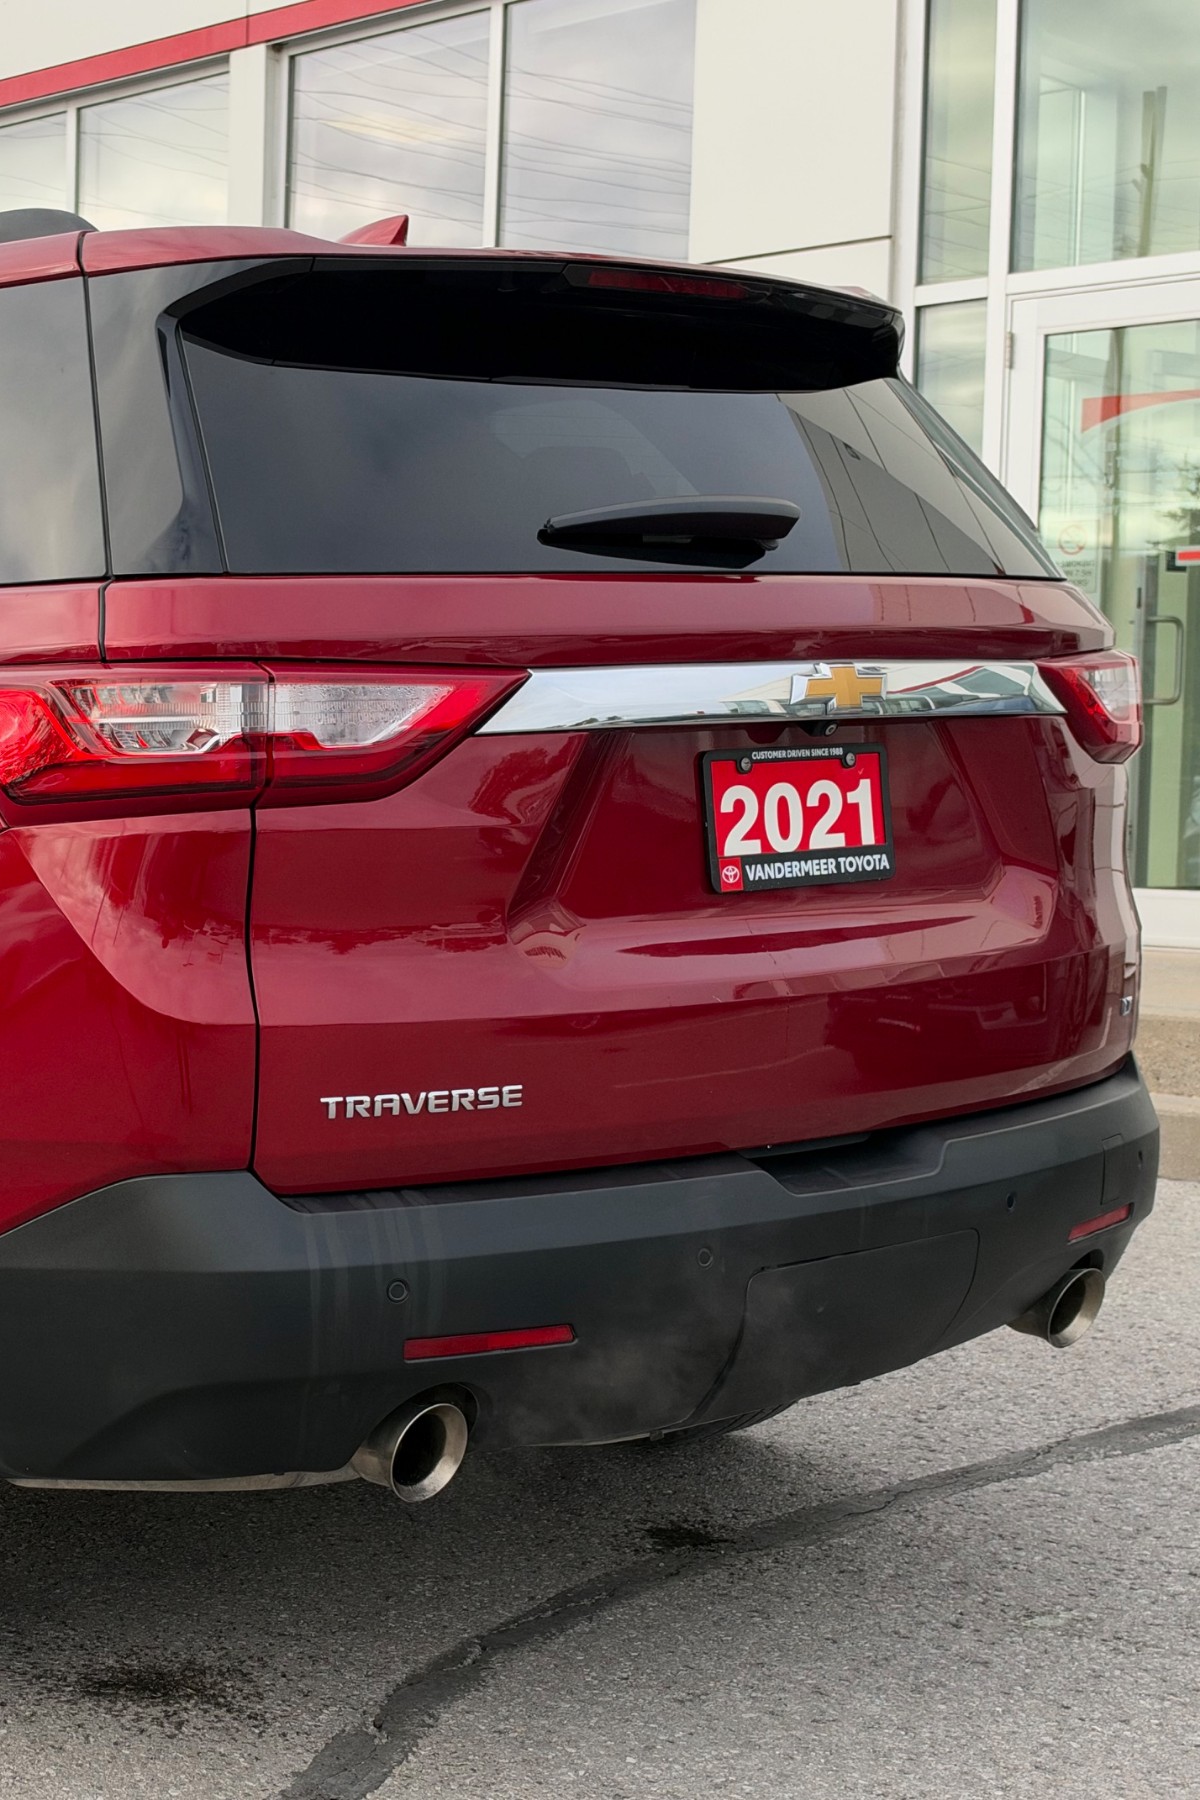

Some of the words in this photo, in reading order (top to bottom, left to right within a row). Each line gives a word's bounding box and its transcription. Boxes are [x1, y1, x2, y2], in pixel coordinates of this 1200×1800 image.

[751, 750, 787, 760] CUSTOMER
[787, 748, 811, 758] DRIVEN
[811, 748, 829, 757] SINCE
[720, 778, 876, 857] 2021
[745, 857, 838, 881] VANDERMEER
[838, 853, 890, 873] TOYOTA
[320, 1084, 524, 1119] TRAVERSE
